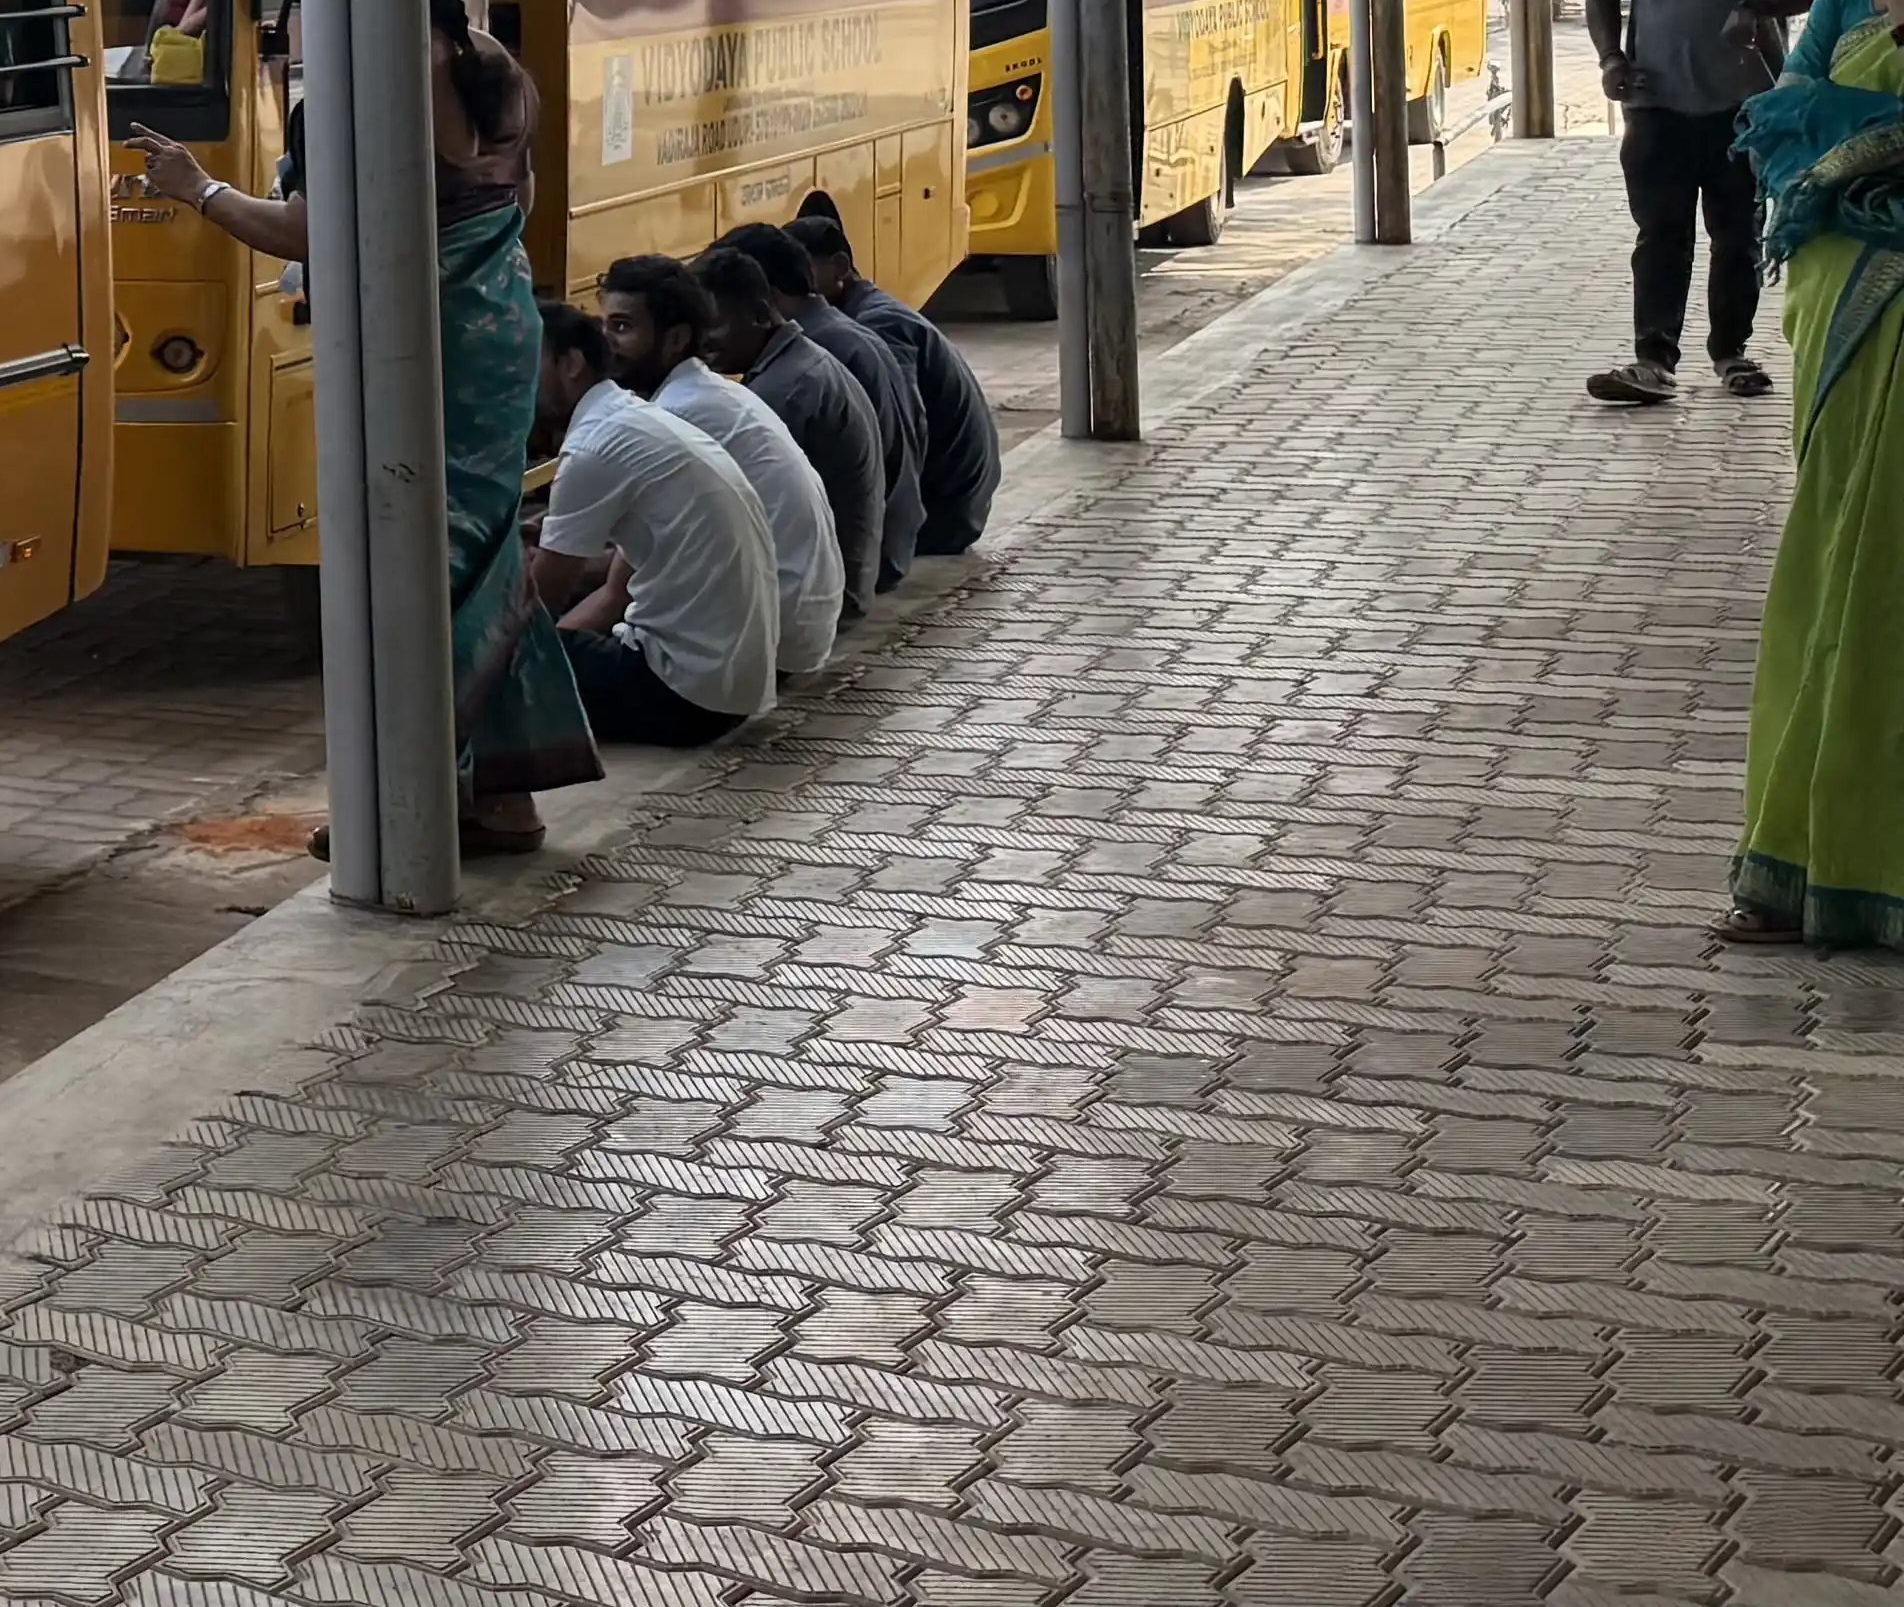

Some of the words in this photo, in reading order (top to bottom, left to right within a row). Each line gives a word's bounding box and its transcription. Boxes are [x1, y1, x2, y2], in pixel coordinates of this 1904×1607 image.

[642, 31, 749, 106] VIDYODAYA
[753, 21, 815, 84] PUBLIC
[821, 10, 881, 72] SCHOOL
